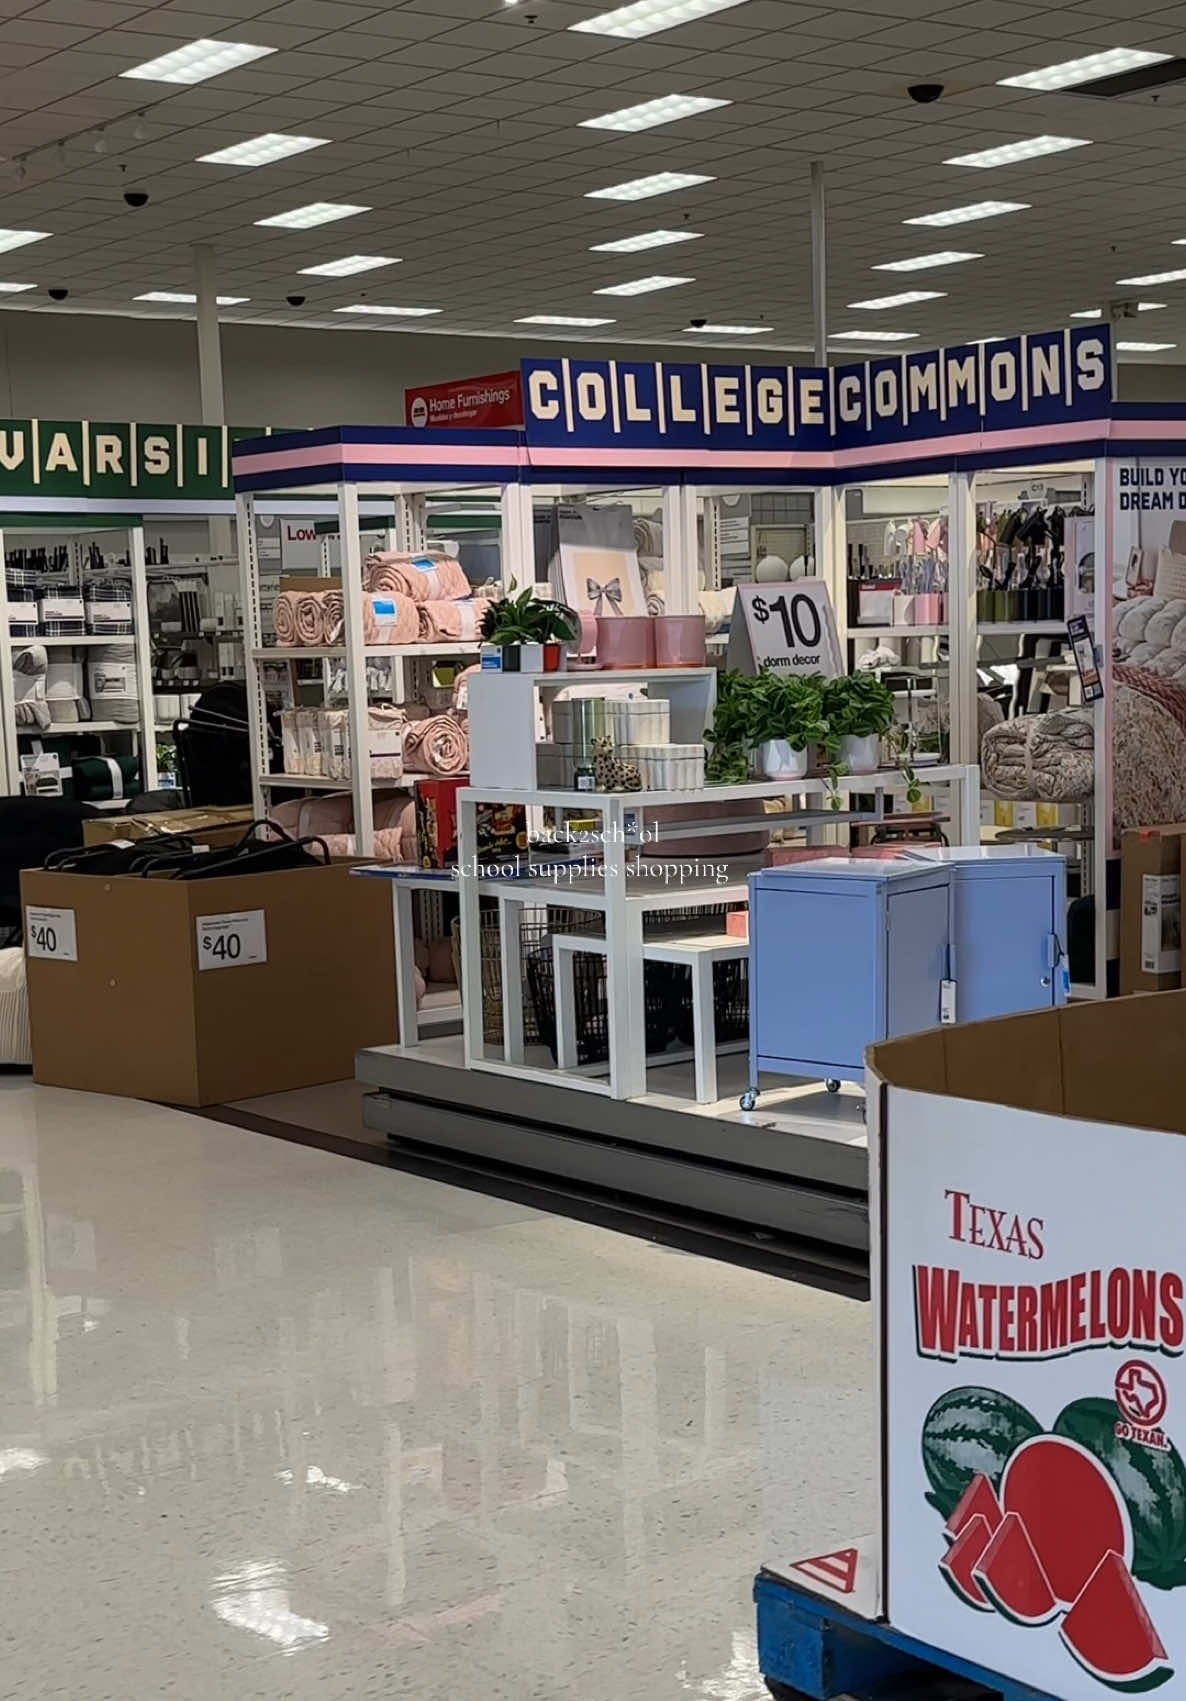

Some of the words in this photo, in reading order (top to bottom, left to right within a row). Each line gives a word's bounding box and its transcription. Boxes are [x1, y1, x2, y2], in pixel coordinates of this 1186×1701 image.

[528, 369, 825, 424] COLLEGE
[839, 338, 1105, 422] COMMONS
[429, 398, 456, 412] Home
[457, 388, 511, 409] Furnishings
[0, 430, 238, 475] VARSI
[1119, 467, 1164, 487] BUILD
[1119, 491, 1174, 511] DREAM
[751, 593, 821, 648] $10
[763, 656, 791, 668] dorm
[792, 653, 821, 666] decor
[31, 924, 57, 952] $40
[202, 933, 241, 960] $40
